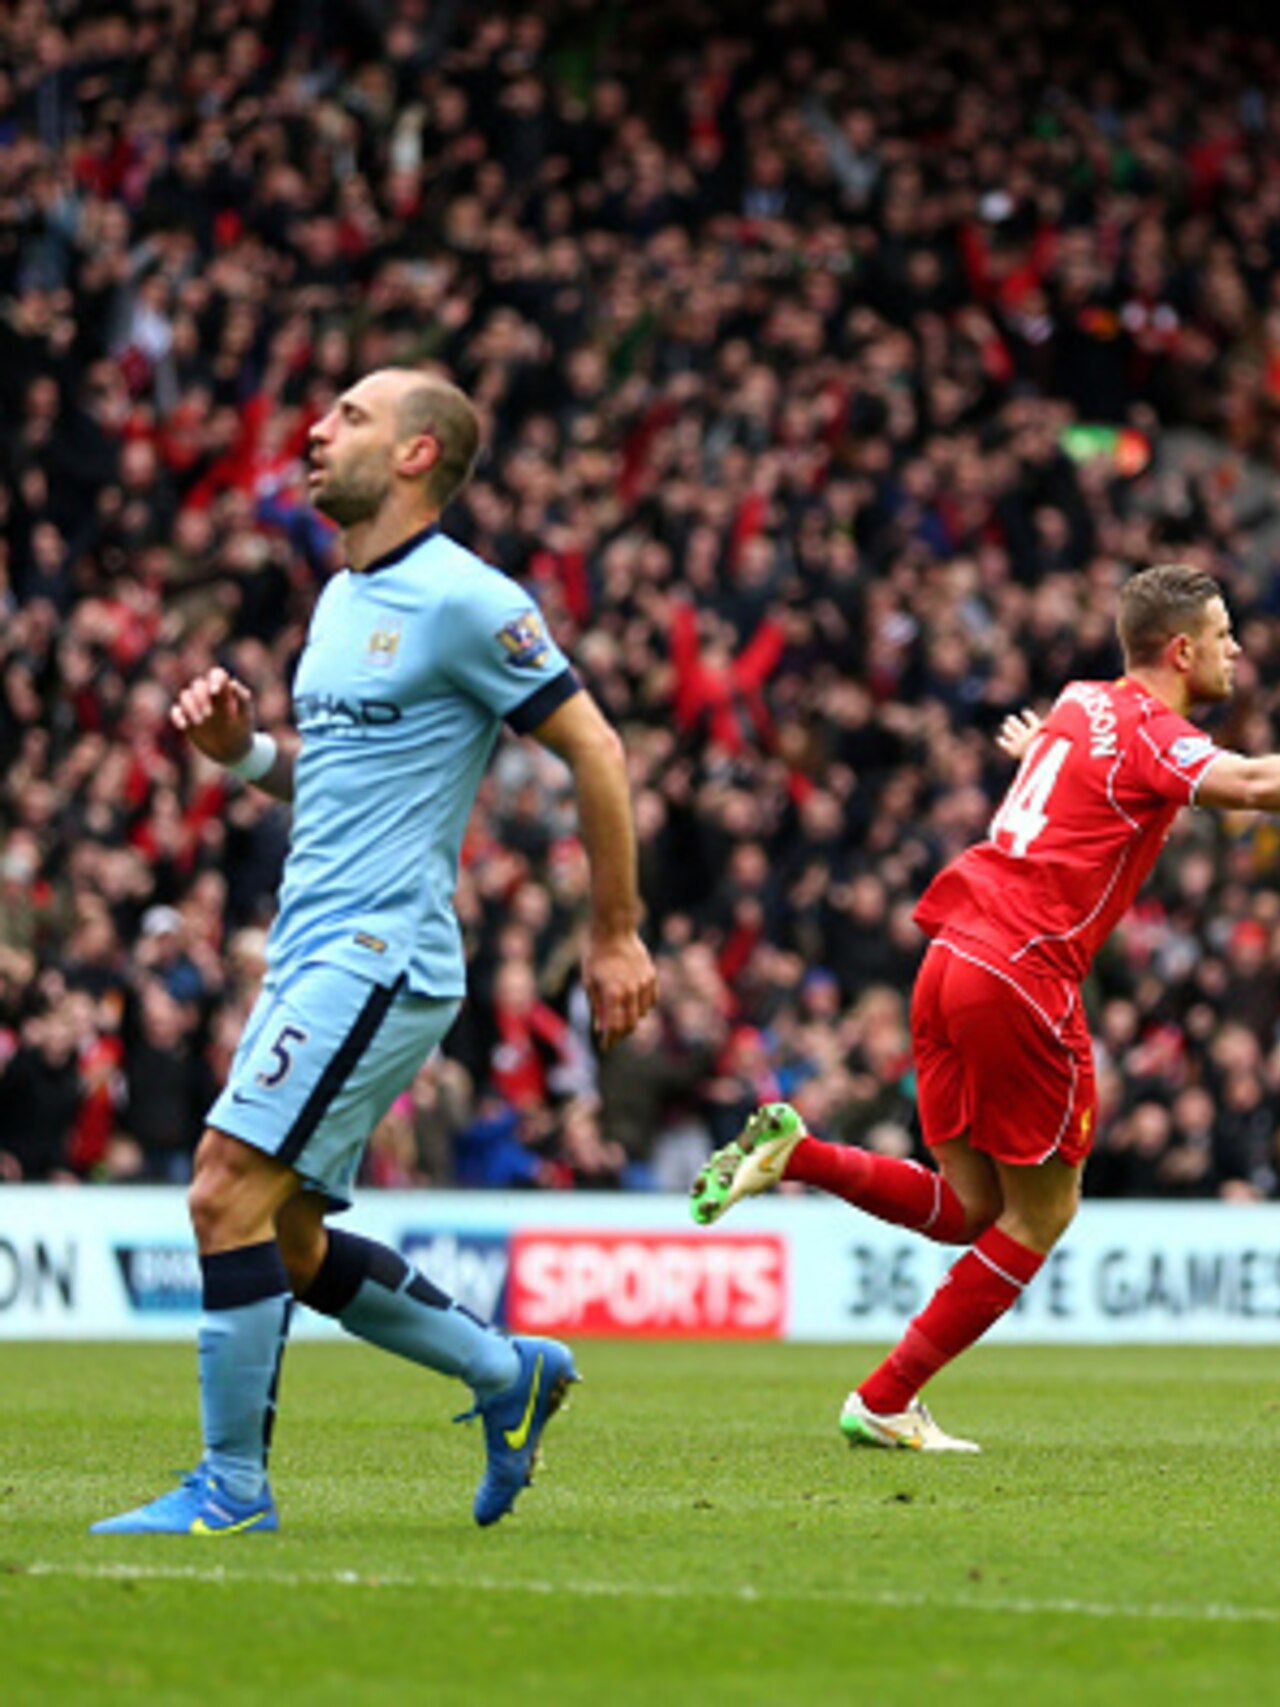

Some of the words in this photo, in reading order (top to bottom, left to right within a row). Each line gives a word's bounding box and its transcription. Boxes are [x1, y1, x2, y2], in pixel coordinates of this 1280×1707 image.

[293, 694, 402, 726] TIHAD
[256, 1024, 307, 1090] 5
[516, 1241, 779, 1327] SPORTS
[848, 1246, 921, 1317] 36
